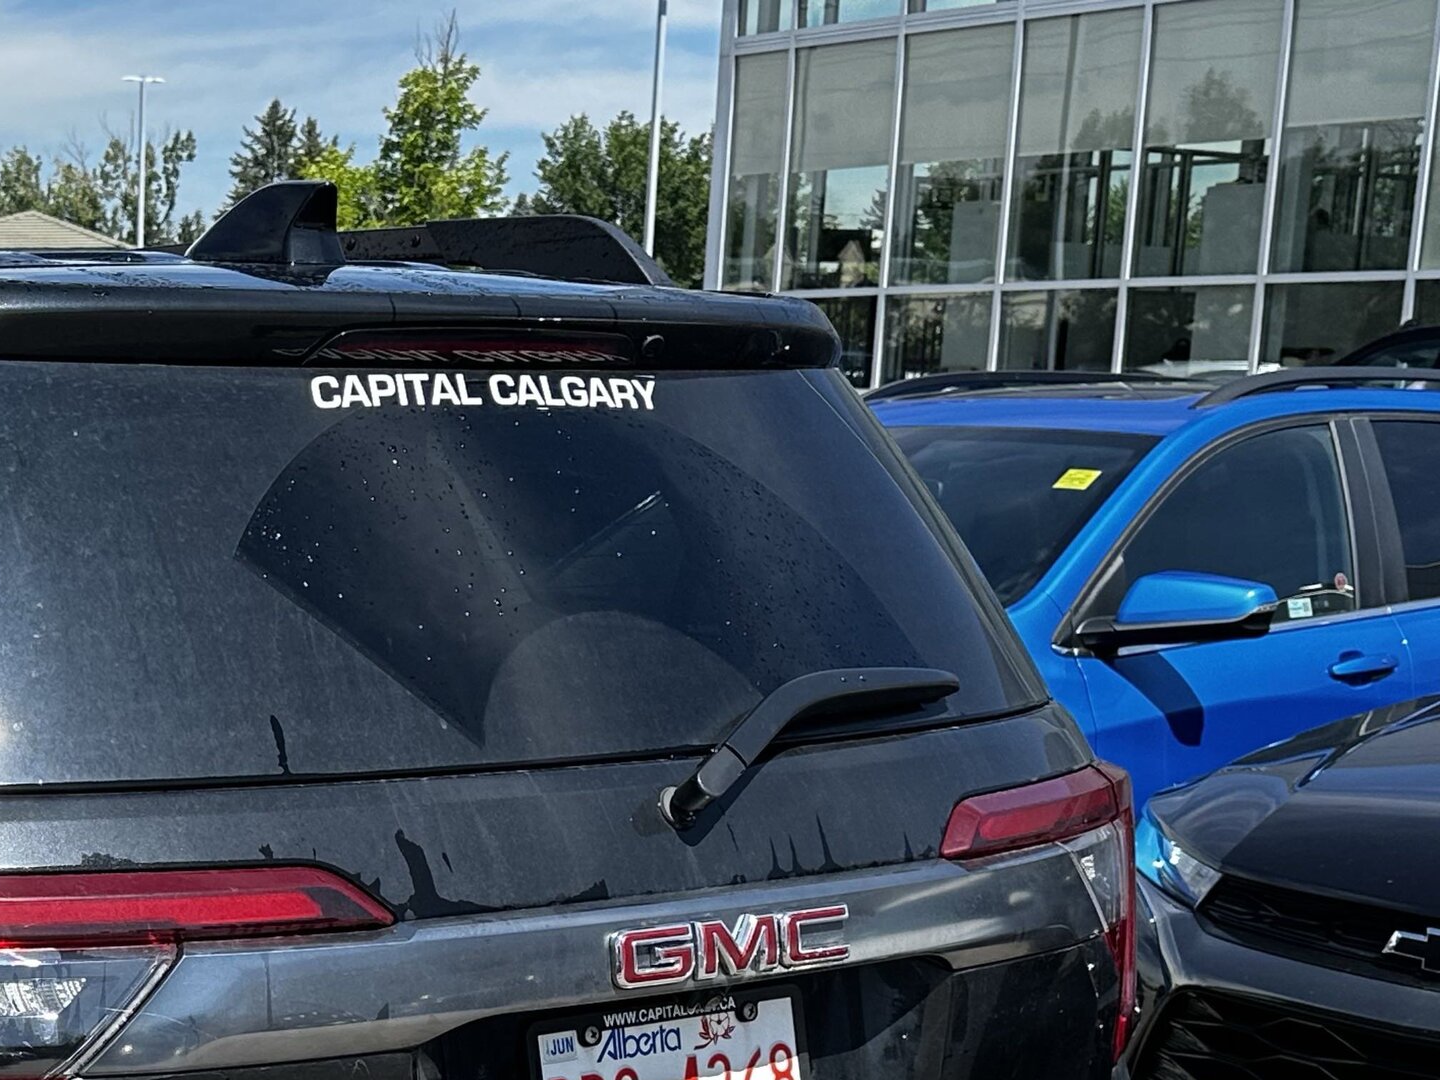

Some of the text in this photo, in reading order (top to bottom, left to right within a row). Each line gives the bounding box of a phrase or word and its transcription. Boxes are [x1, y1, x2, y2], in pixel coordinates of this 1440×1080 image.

[311, 373, 655, 410] CAPITAL CALGARY
[611, 904, 850, 989] GMC
[551, 1036, 574, 1056] JUN
[597, 1024, 682, 1063] Alberta
